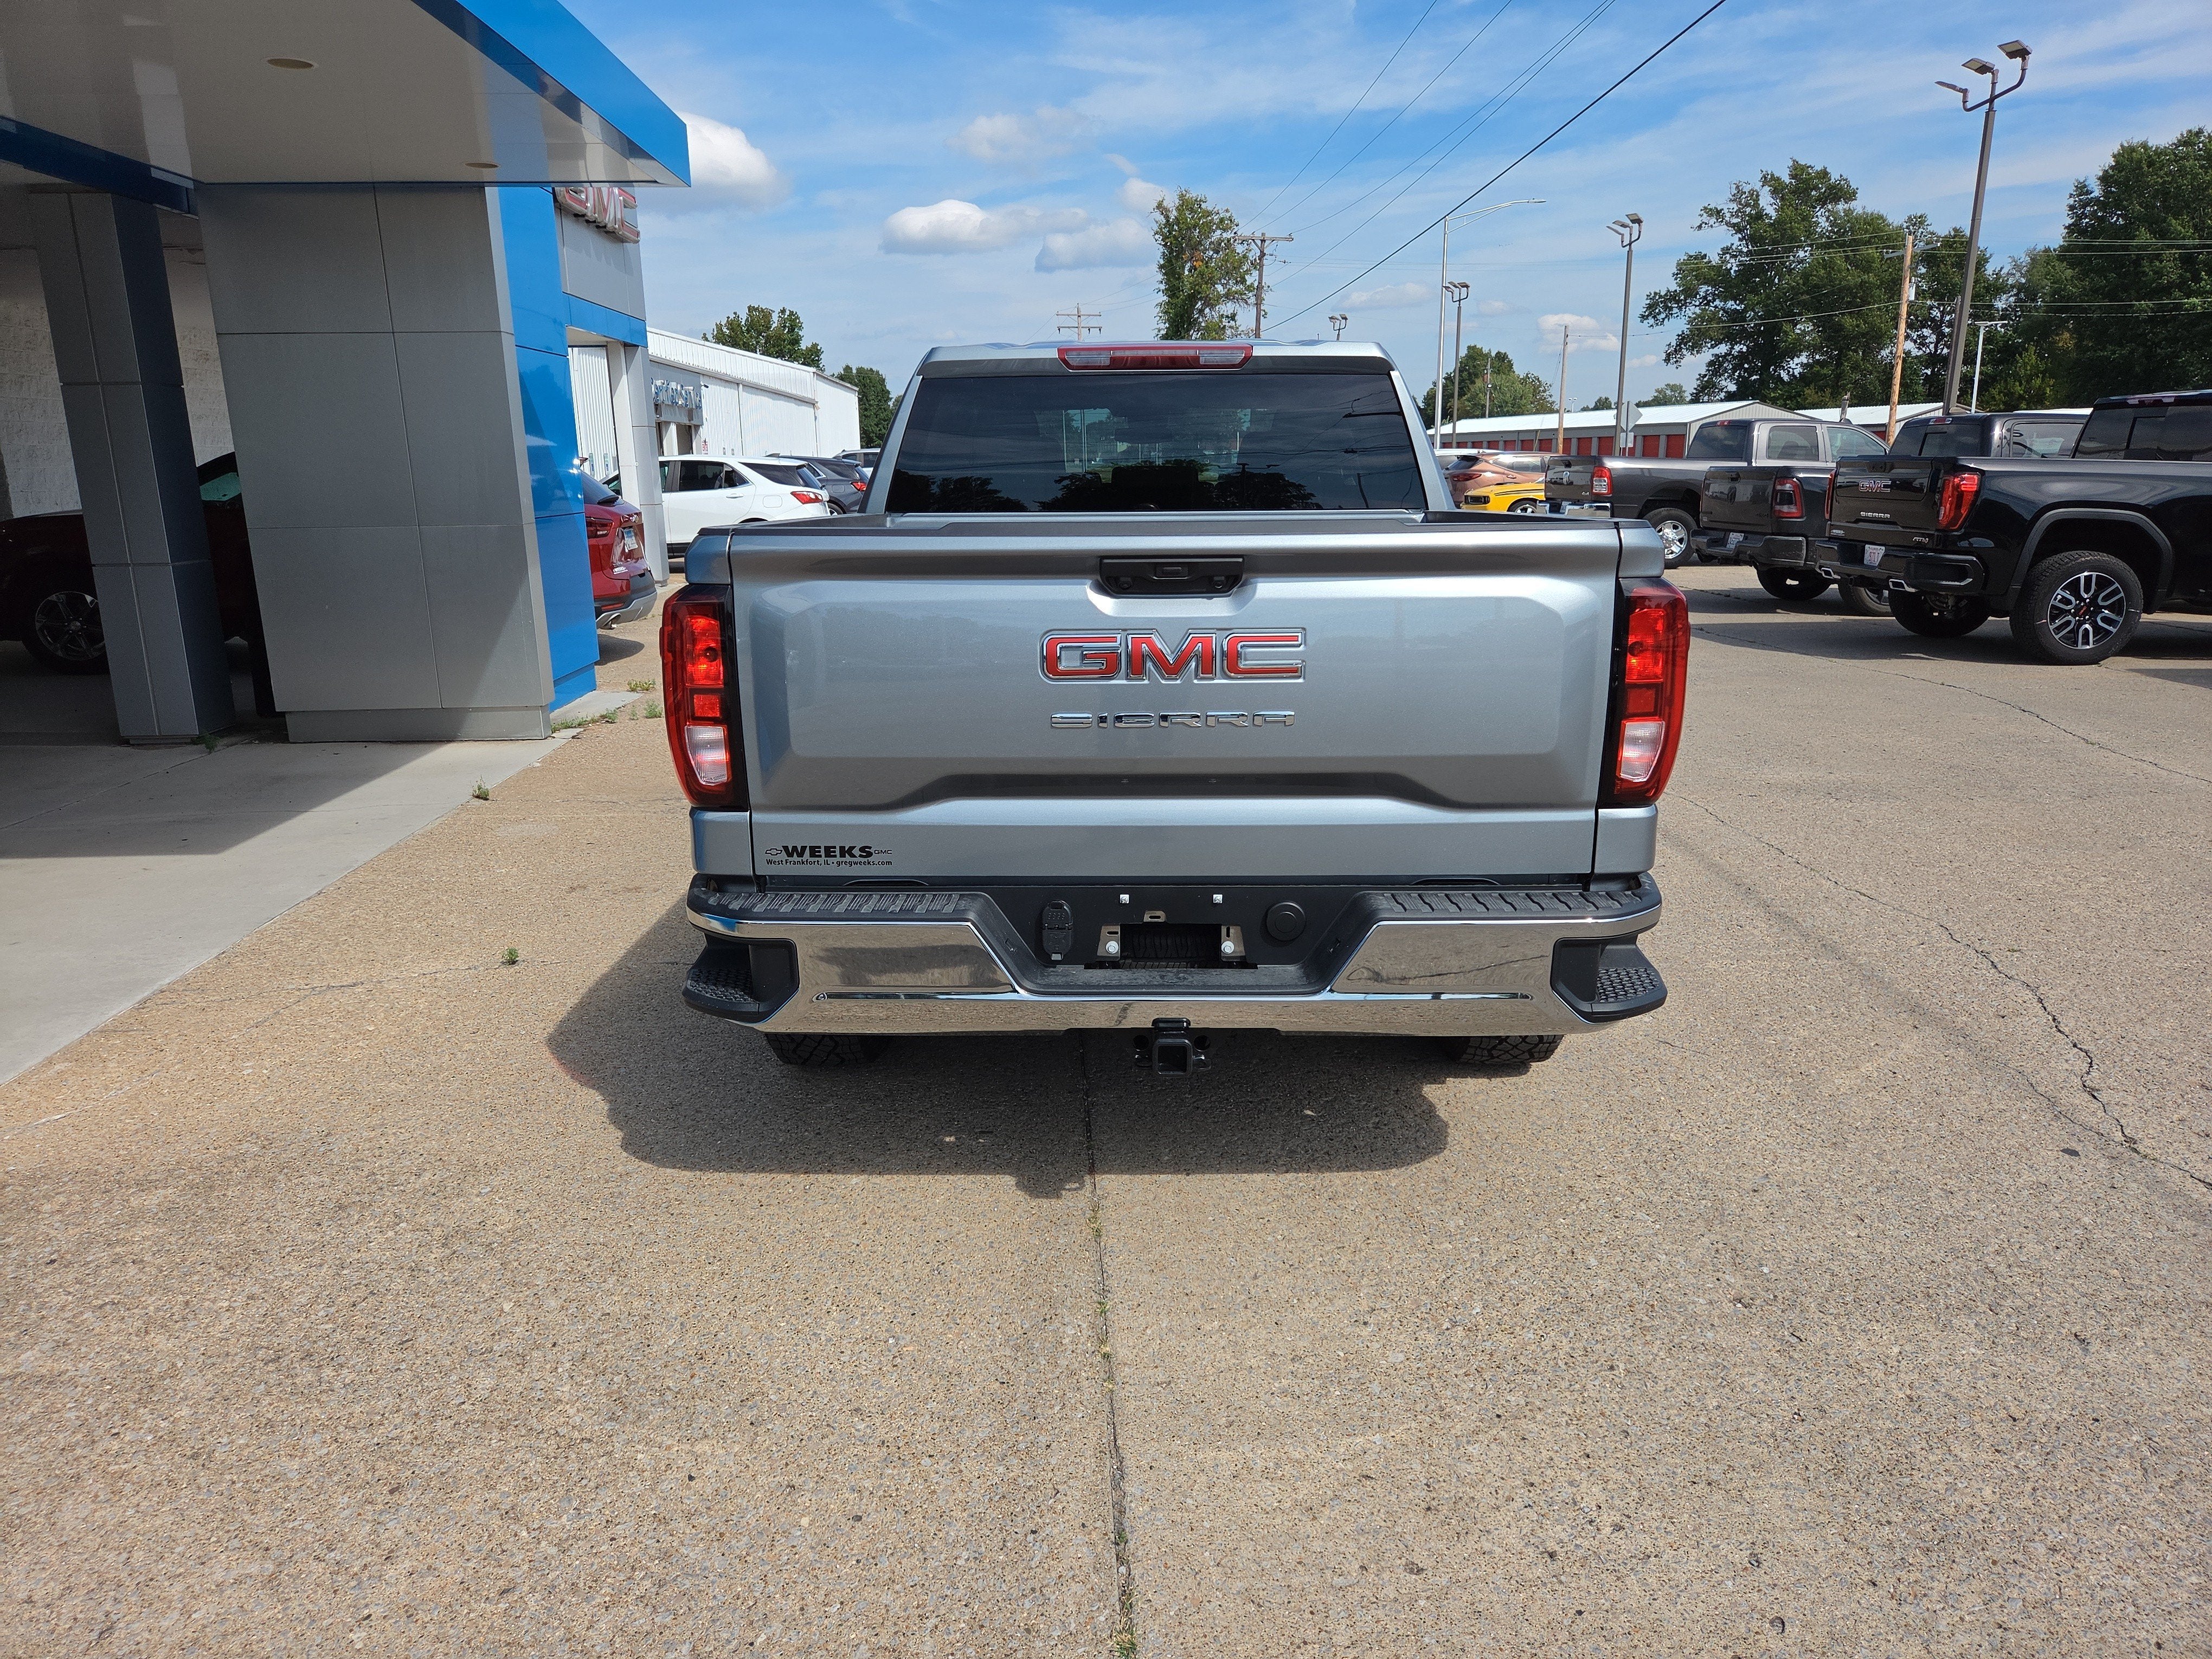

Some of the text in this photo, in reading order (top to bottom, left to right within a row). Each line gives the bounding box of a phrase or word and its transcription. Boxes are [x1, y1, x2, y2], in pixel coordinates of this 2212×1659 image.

[1859, 480, 1892, 492] GMC
[1041, 629, 1304, 681] GMC
[1050, 711, 1296, 728] SIERRA
[782, 845, 873, 858] WEEKS
[836, 859, 892, 867] gregweeks.com
